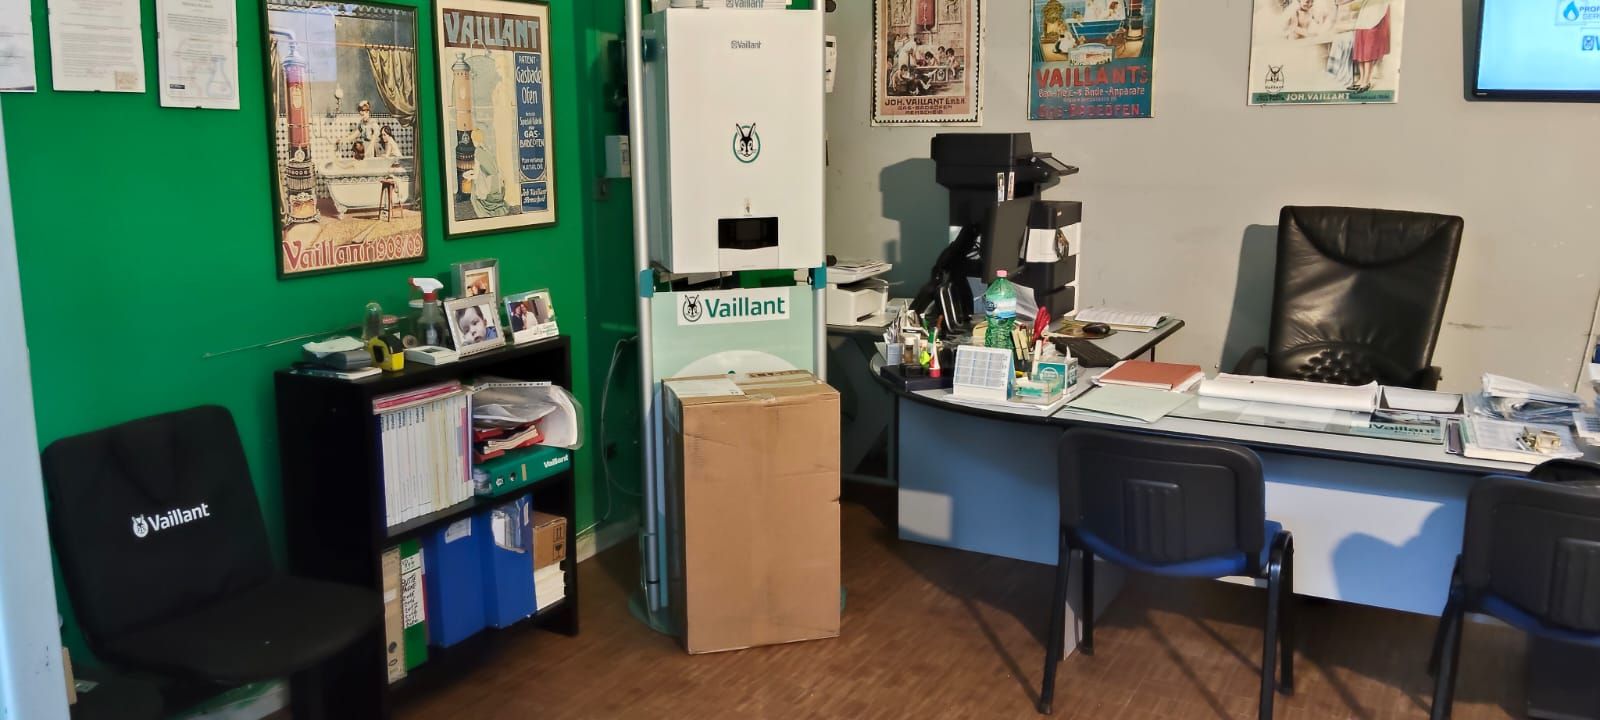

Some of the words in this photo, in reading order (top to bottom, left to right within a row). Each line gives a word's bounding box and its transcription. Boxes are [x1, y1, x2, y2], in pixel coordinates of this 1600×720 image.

[443, 11, 539, 49] VAILLANT
[738, 41, 762, 49] Vaillant
[518, 55, 536, 65] PATENT
[521, 86, 538, 105] Ofen
[907, 97, 943, 105] VAILLANT
[1307, 92, 1350, 101] VAILLANT
[283, 240, 373, 271] Vaillant
[705, 297, 786, 318] Vaillant
[544, 454, 568, 468] Vaillant
[147, 503, 210, 531] Vaillant
